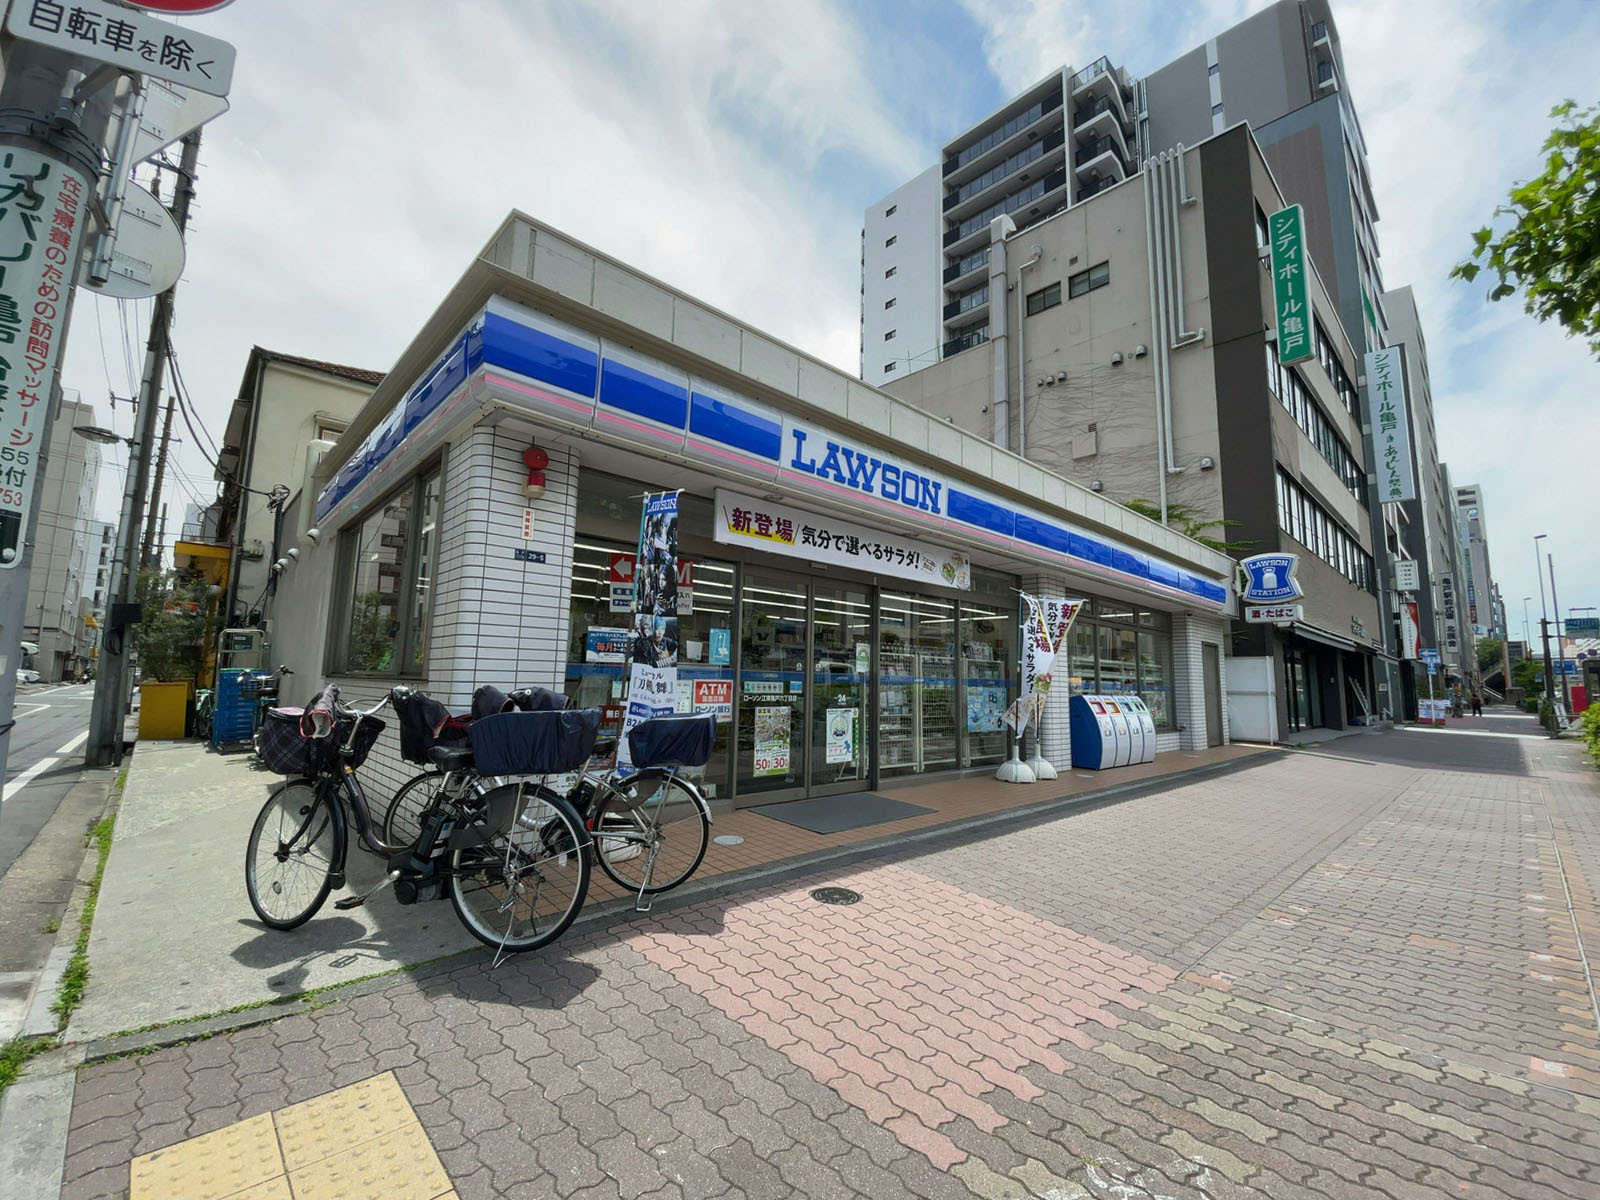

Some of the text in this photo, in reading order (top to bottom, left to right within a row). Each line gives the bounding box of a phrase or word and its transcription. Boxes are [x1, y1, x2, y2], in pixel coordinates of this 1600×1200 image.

[29, 0, 215, 80] 自転車を除く
[1275, 217, 1305, 355] シティホール亀戸
[9, 172, 82, 446] 在宅療養のための訪問マッサージ
[1374, 353, 1398, 435] シティホール亀戸
[791, 429, 941, 514] LAWSON
[0, 488, 23, 507] 53
[647, 499, 677, 512] LAWSON
[732, 507, 794, 543] 新登場
[801, 525, 920, 570] 気分で選べるサラダ!
[1249, 558, 1288, 569] LAWSON
[1250, 586, 1291, 596] STATION
[699, 683, 728, 696] ATM
[838, 694, 847, 702] 24
[695, 705, 731, 714] ローソン銀行
[774, 757, 785, 768] 30
